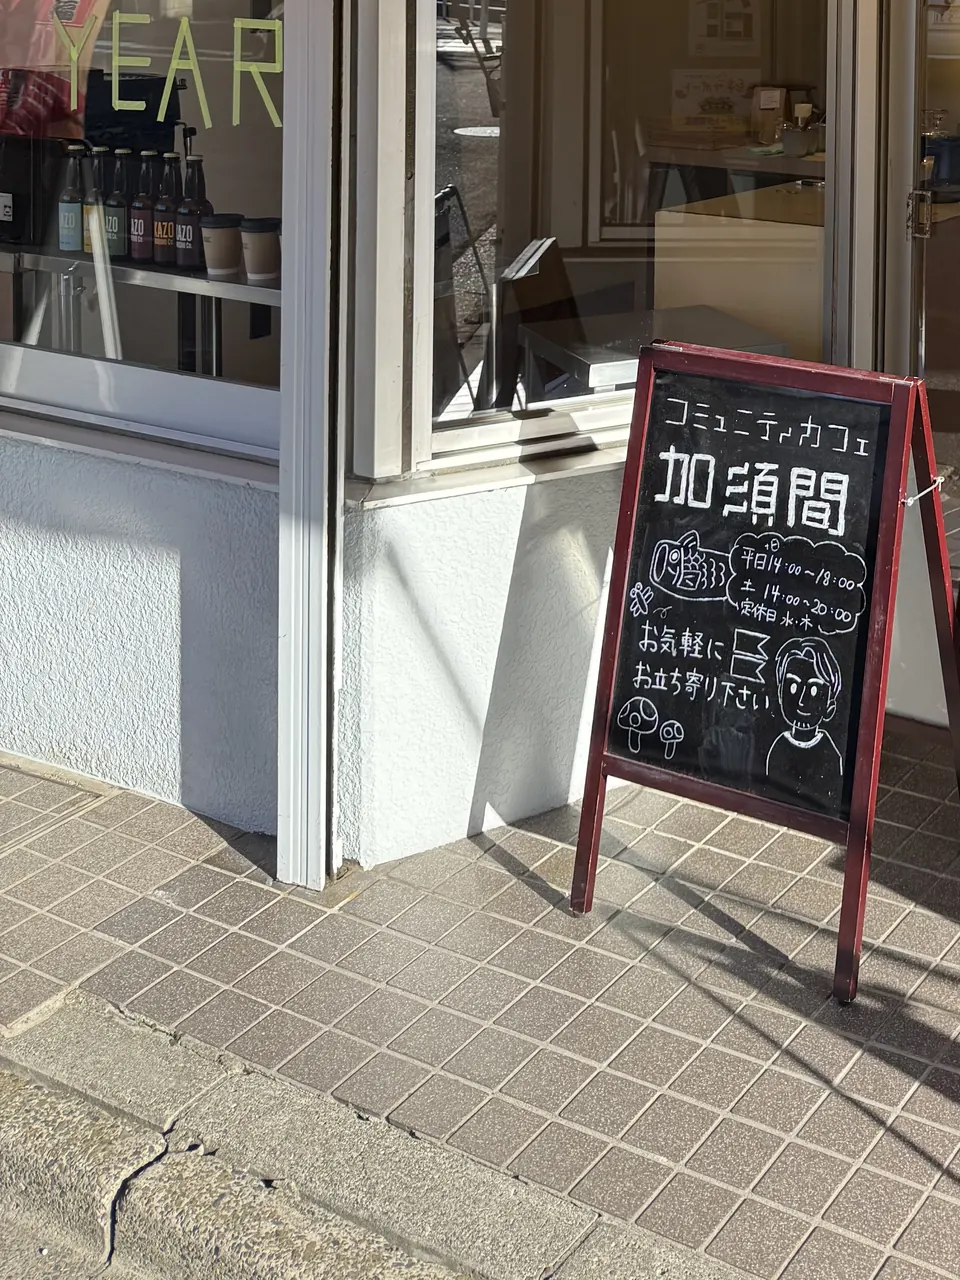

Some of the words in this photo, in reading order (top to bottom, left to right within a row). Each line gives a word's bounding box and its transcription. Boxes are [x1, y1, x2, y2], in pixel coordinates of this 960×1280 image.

[54, 9, 283, 130] YEAR
[665, 397, 869, 457] コミュニティカフェ
[654, 445, 850, 537] 加須間
[740, 578, 756, 592] 土
[740, 597, 777, 622] 定休日
[638, 619, 725, 661] お気軽に
[632, 660, 770, 710] お立ち寄り下さい
